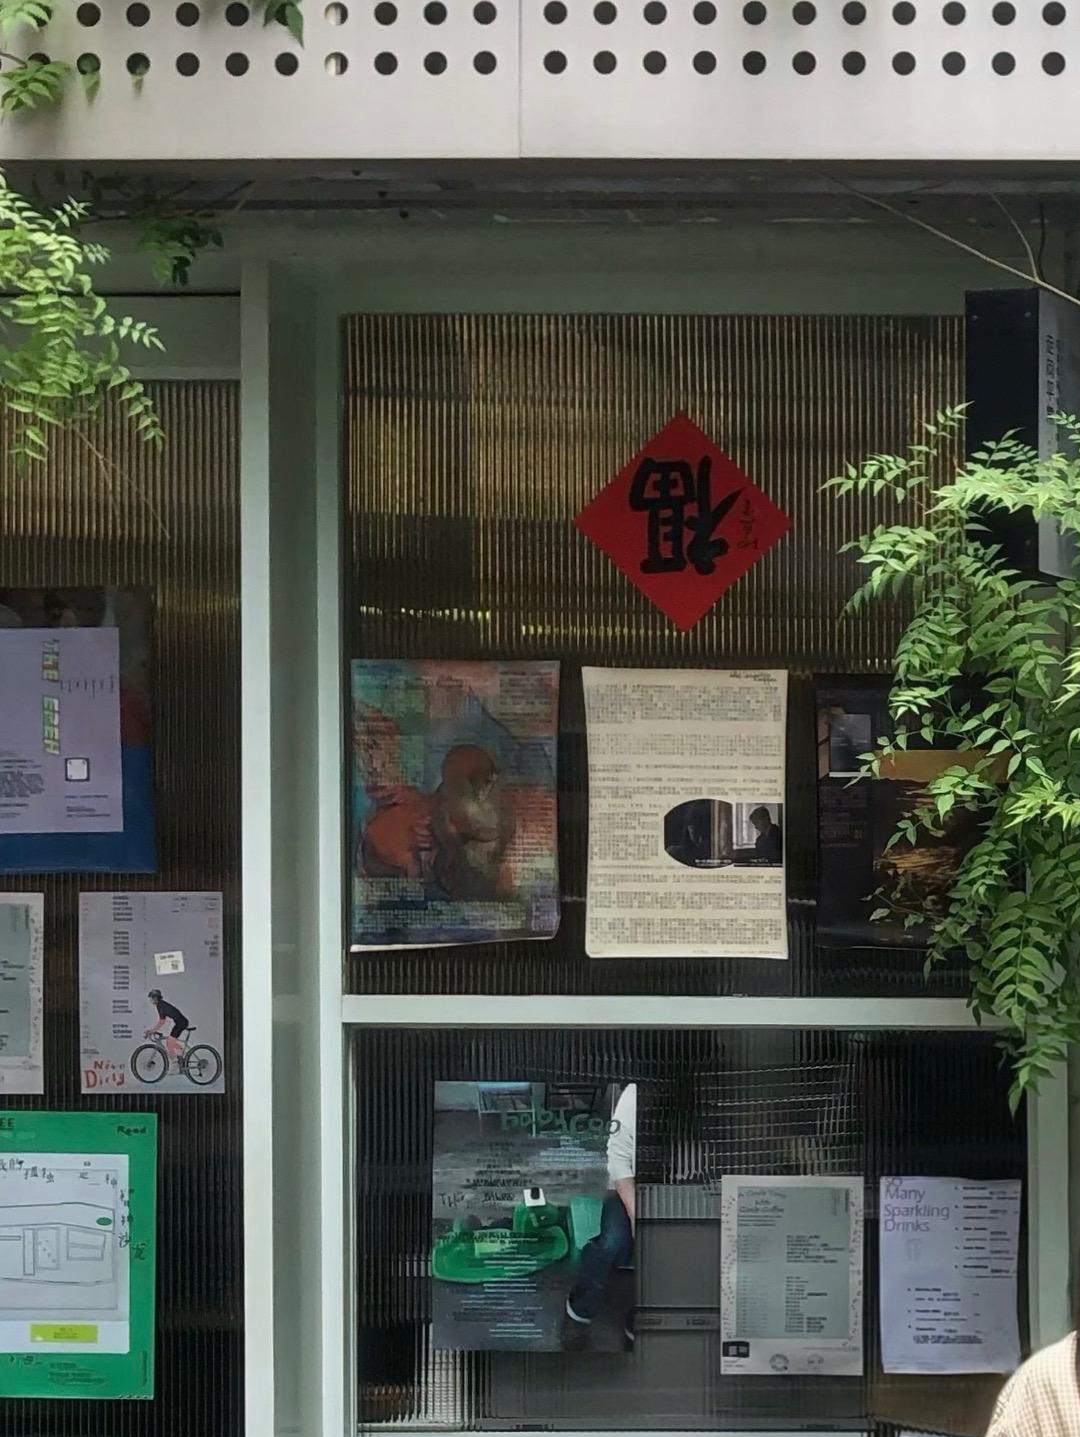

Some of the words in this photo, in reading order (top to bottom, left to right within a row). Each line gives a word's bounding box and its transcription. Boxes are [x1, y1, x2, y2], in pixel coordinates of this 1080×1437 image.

[628, 455, 745, 576] 福
[885, 1185, 926, 1203] Many
[884, 1204, 950, 1221] Sparkling
[884, 1217, 931, 1233] Drinks
